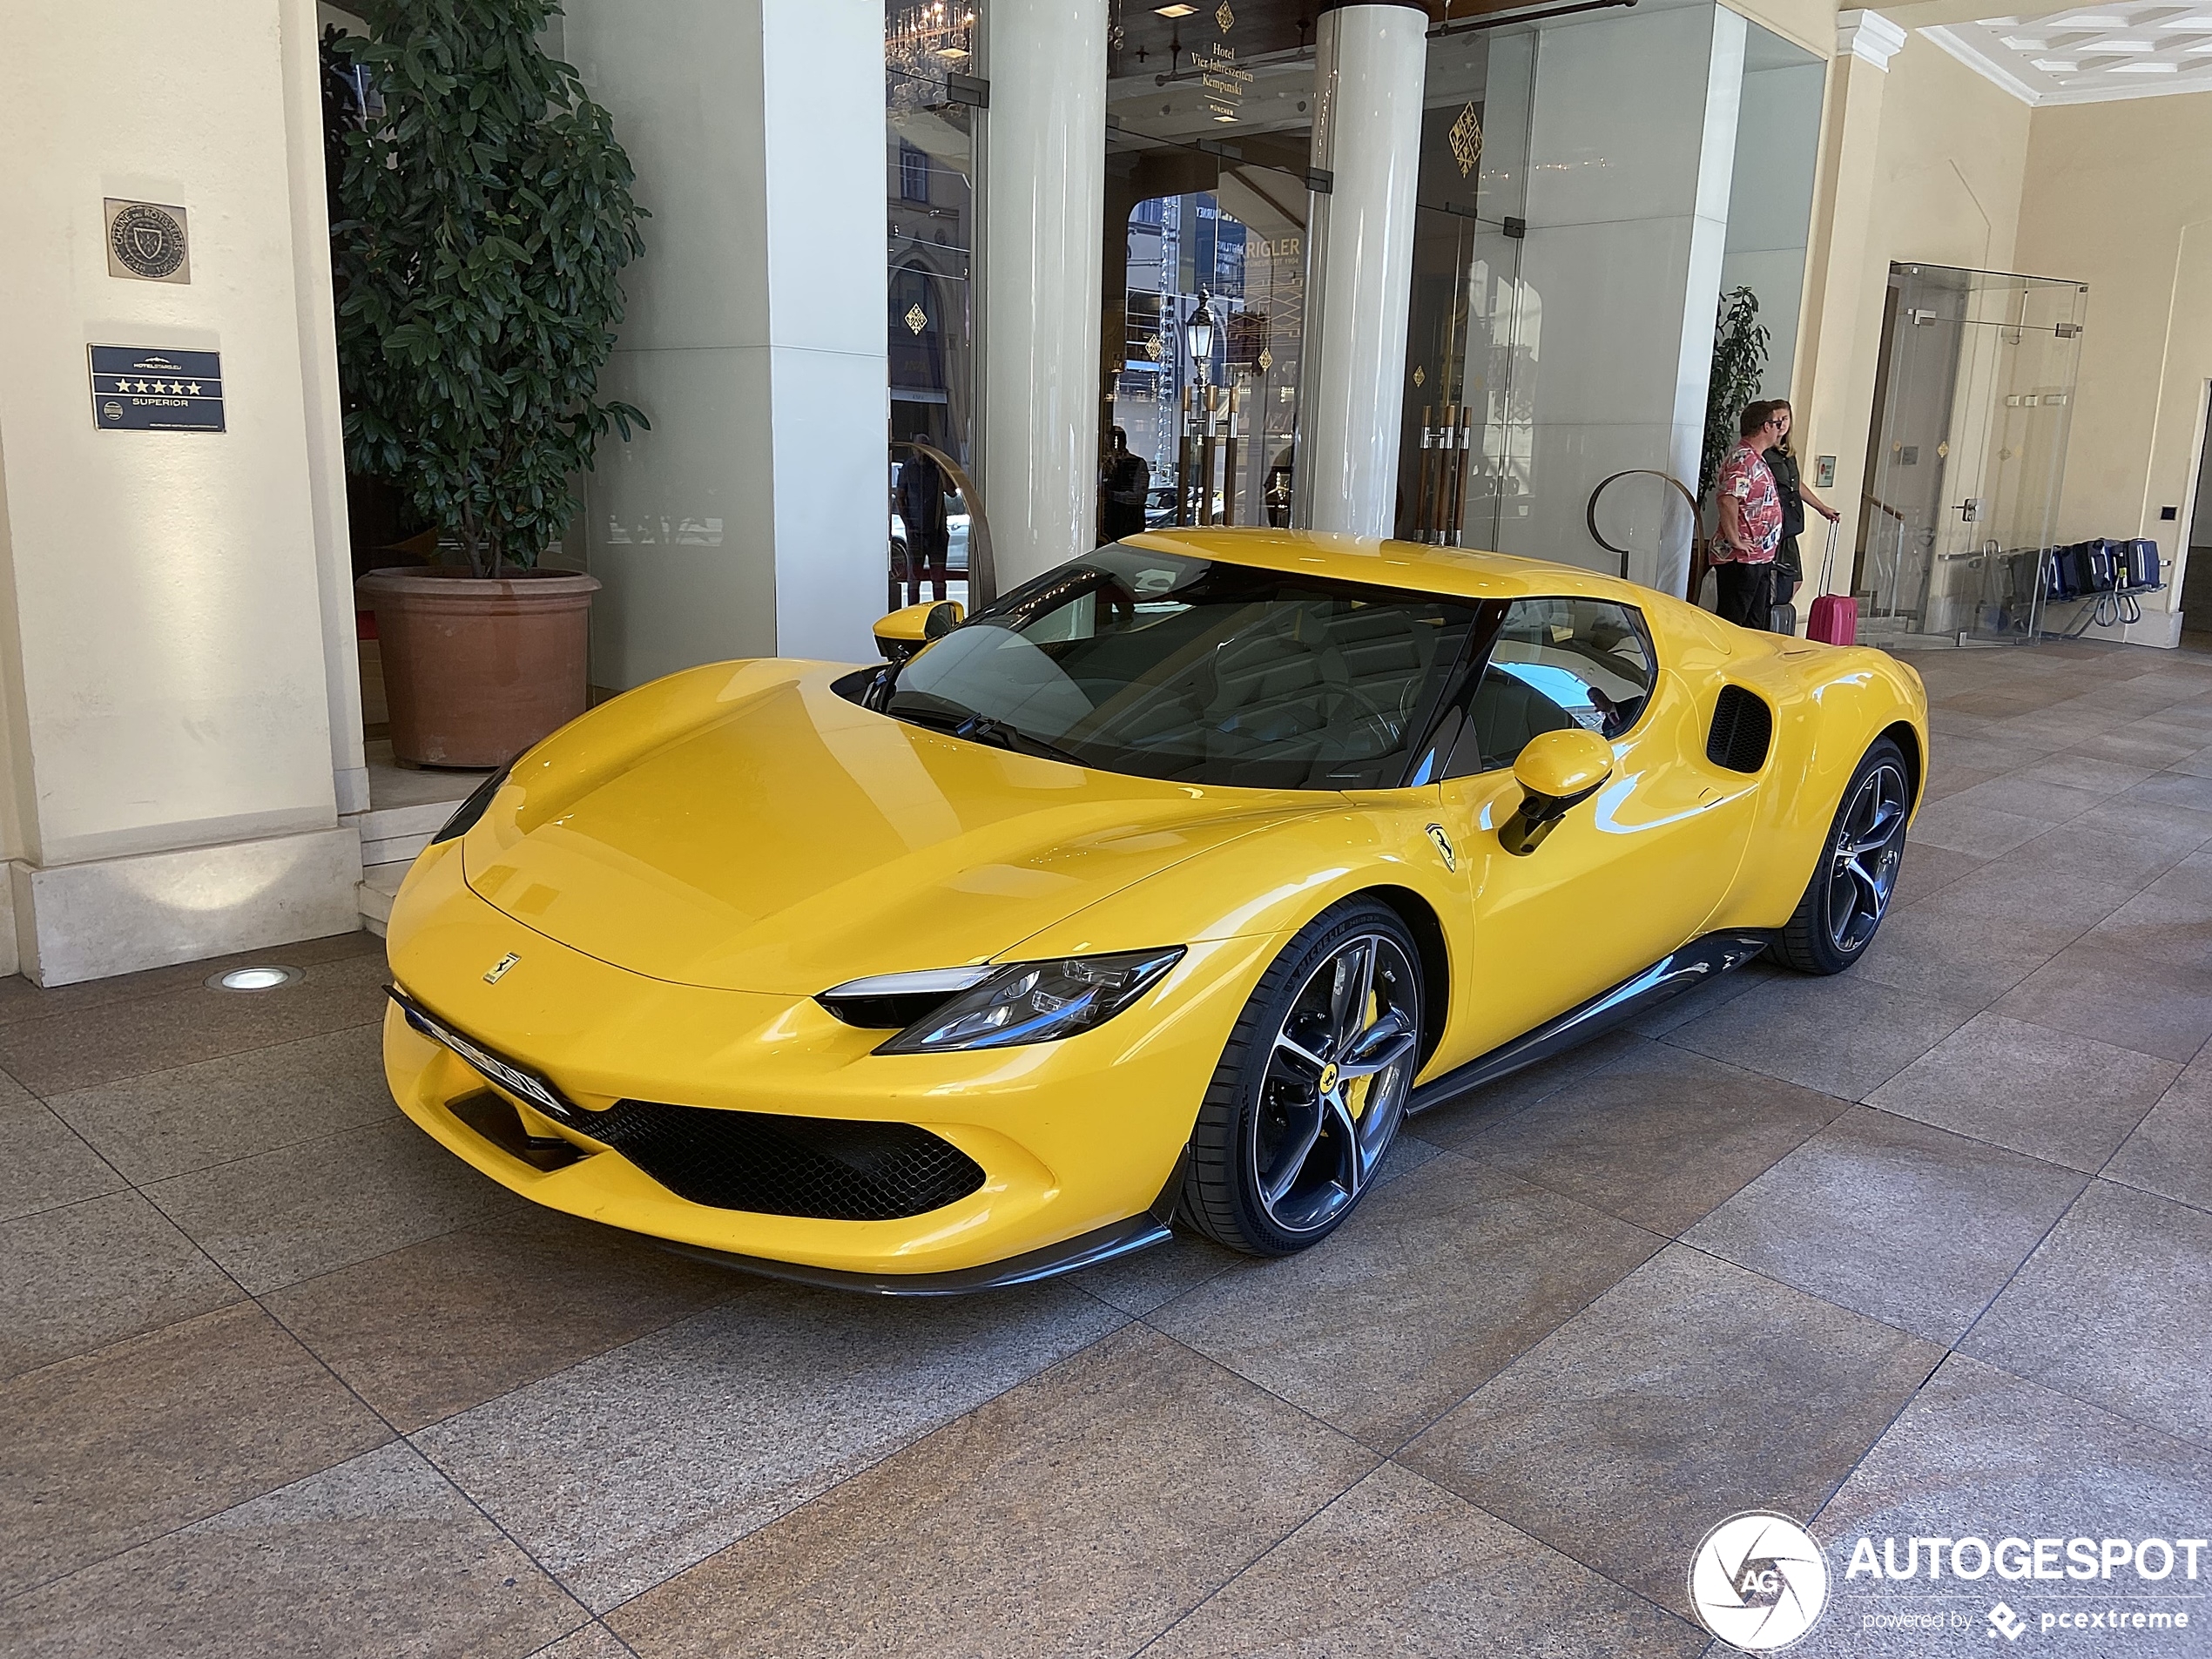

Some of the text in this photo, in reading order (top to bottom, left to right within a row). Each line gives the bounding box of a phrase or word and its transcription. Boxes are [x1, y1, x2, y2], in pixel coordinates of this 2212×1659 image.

[1213, 43, 1235, 60] Hotel
[1191, 52, 1254, 83] Vier Jahreszeiten
[1203, 73, 1242, 96] Kempinski
[1210, 105, 1234, 116] MÜNCHEN
[124, 254, 176, 273] 1248 1950
[132, 397, 189, 407] SUPERIOR
[1298, 923, 1346, 974] MICHELIN
